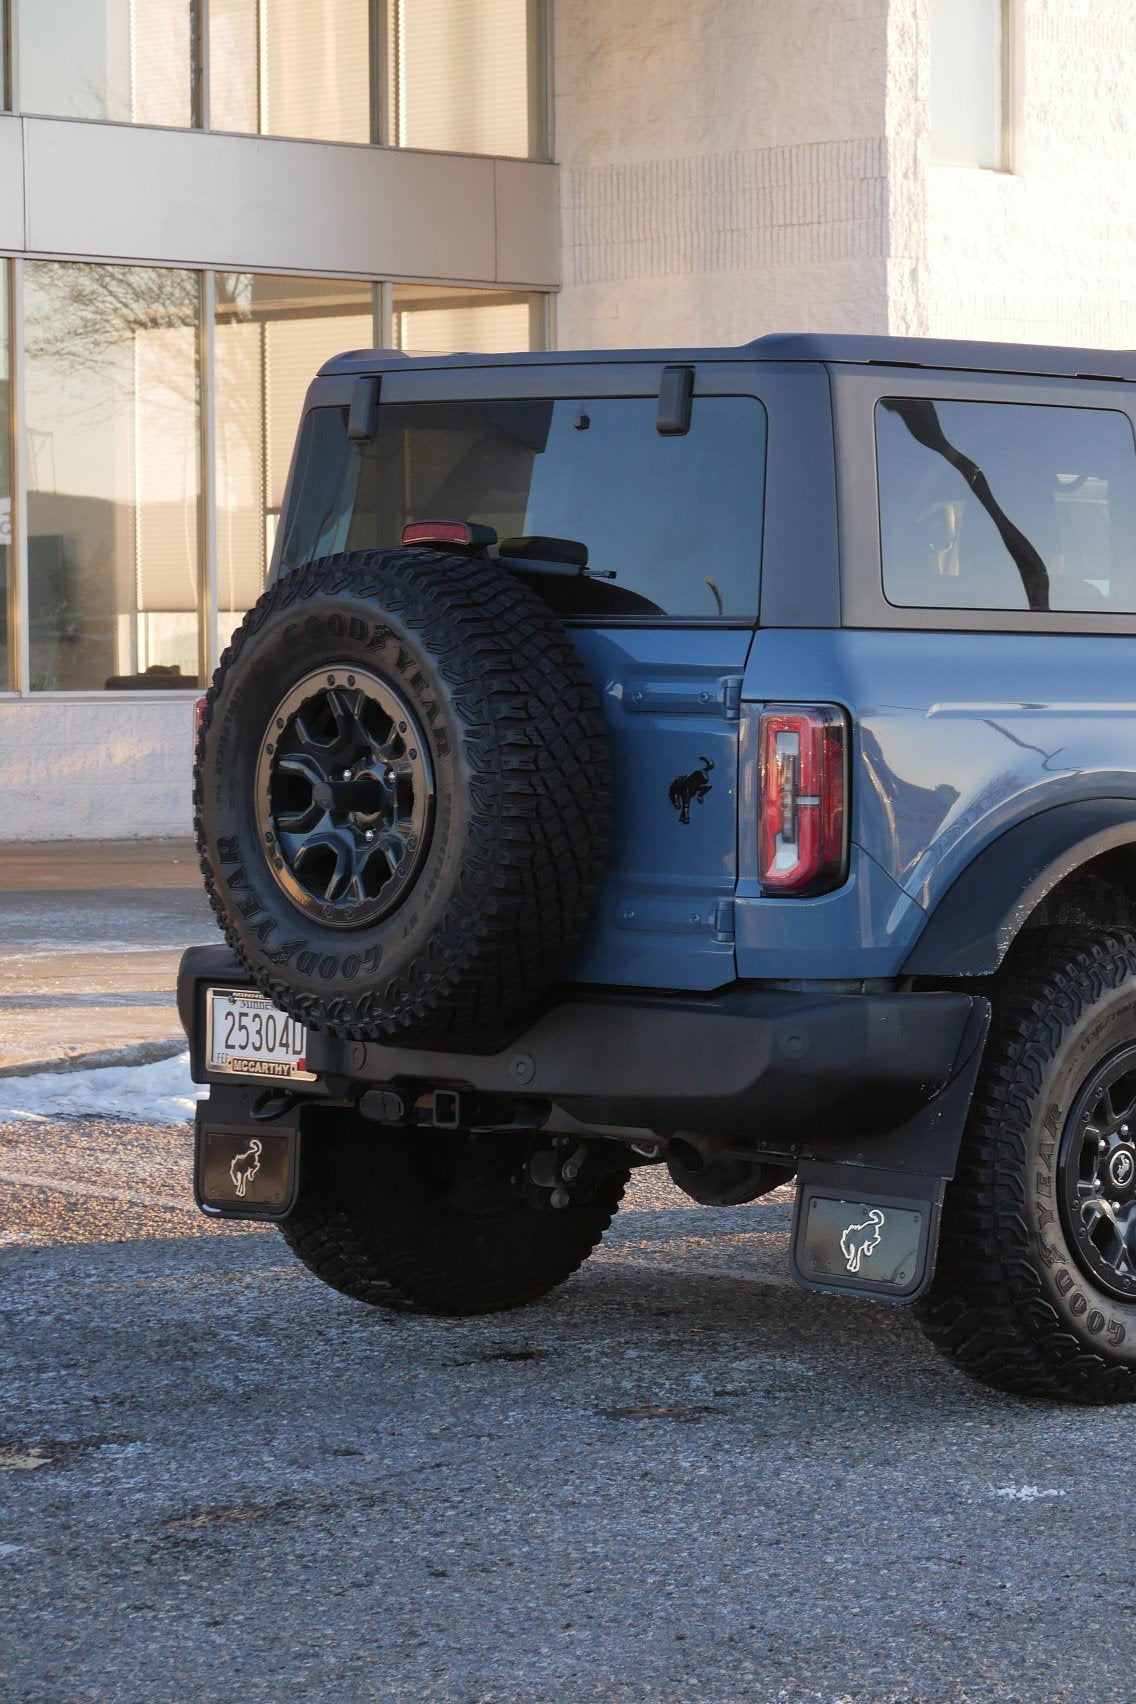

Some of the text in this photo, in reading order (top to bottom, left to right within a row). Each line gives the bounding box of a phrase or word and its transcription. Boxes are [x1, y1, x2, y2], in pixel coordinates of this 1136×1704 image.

[283, 613, 450, 758] GOODYEAR
[216, 834, 383, 982] GOODYEAR
[224, 1010, 304, 1056] 25304D
[233, 1059, 290, 1075] MCCARTHY
[1036, 1103, 1126, 1347] GOODYEAR
